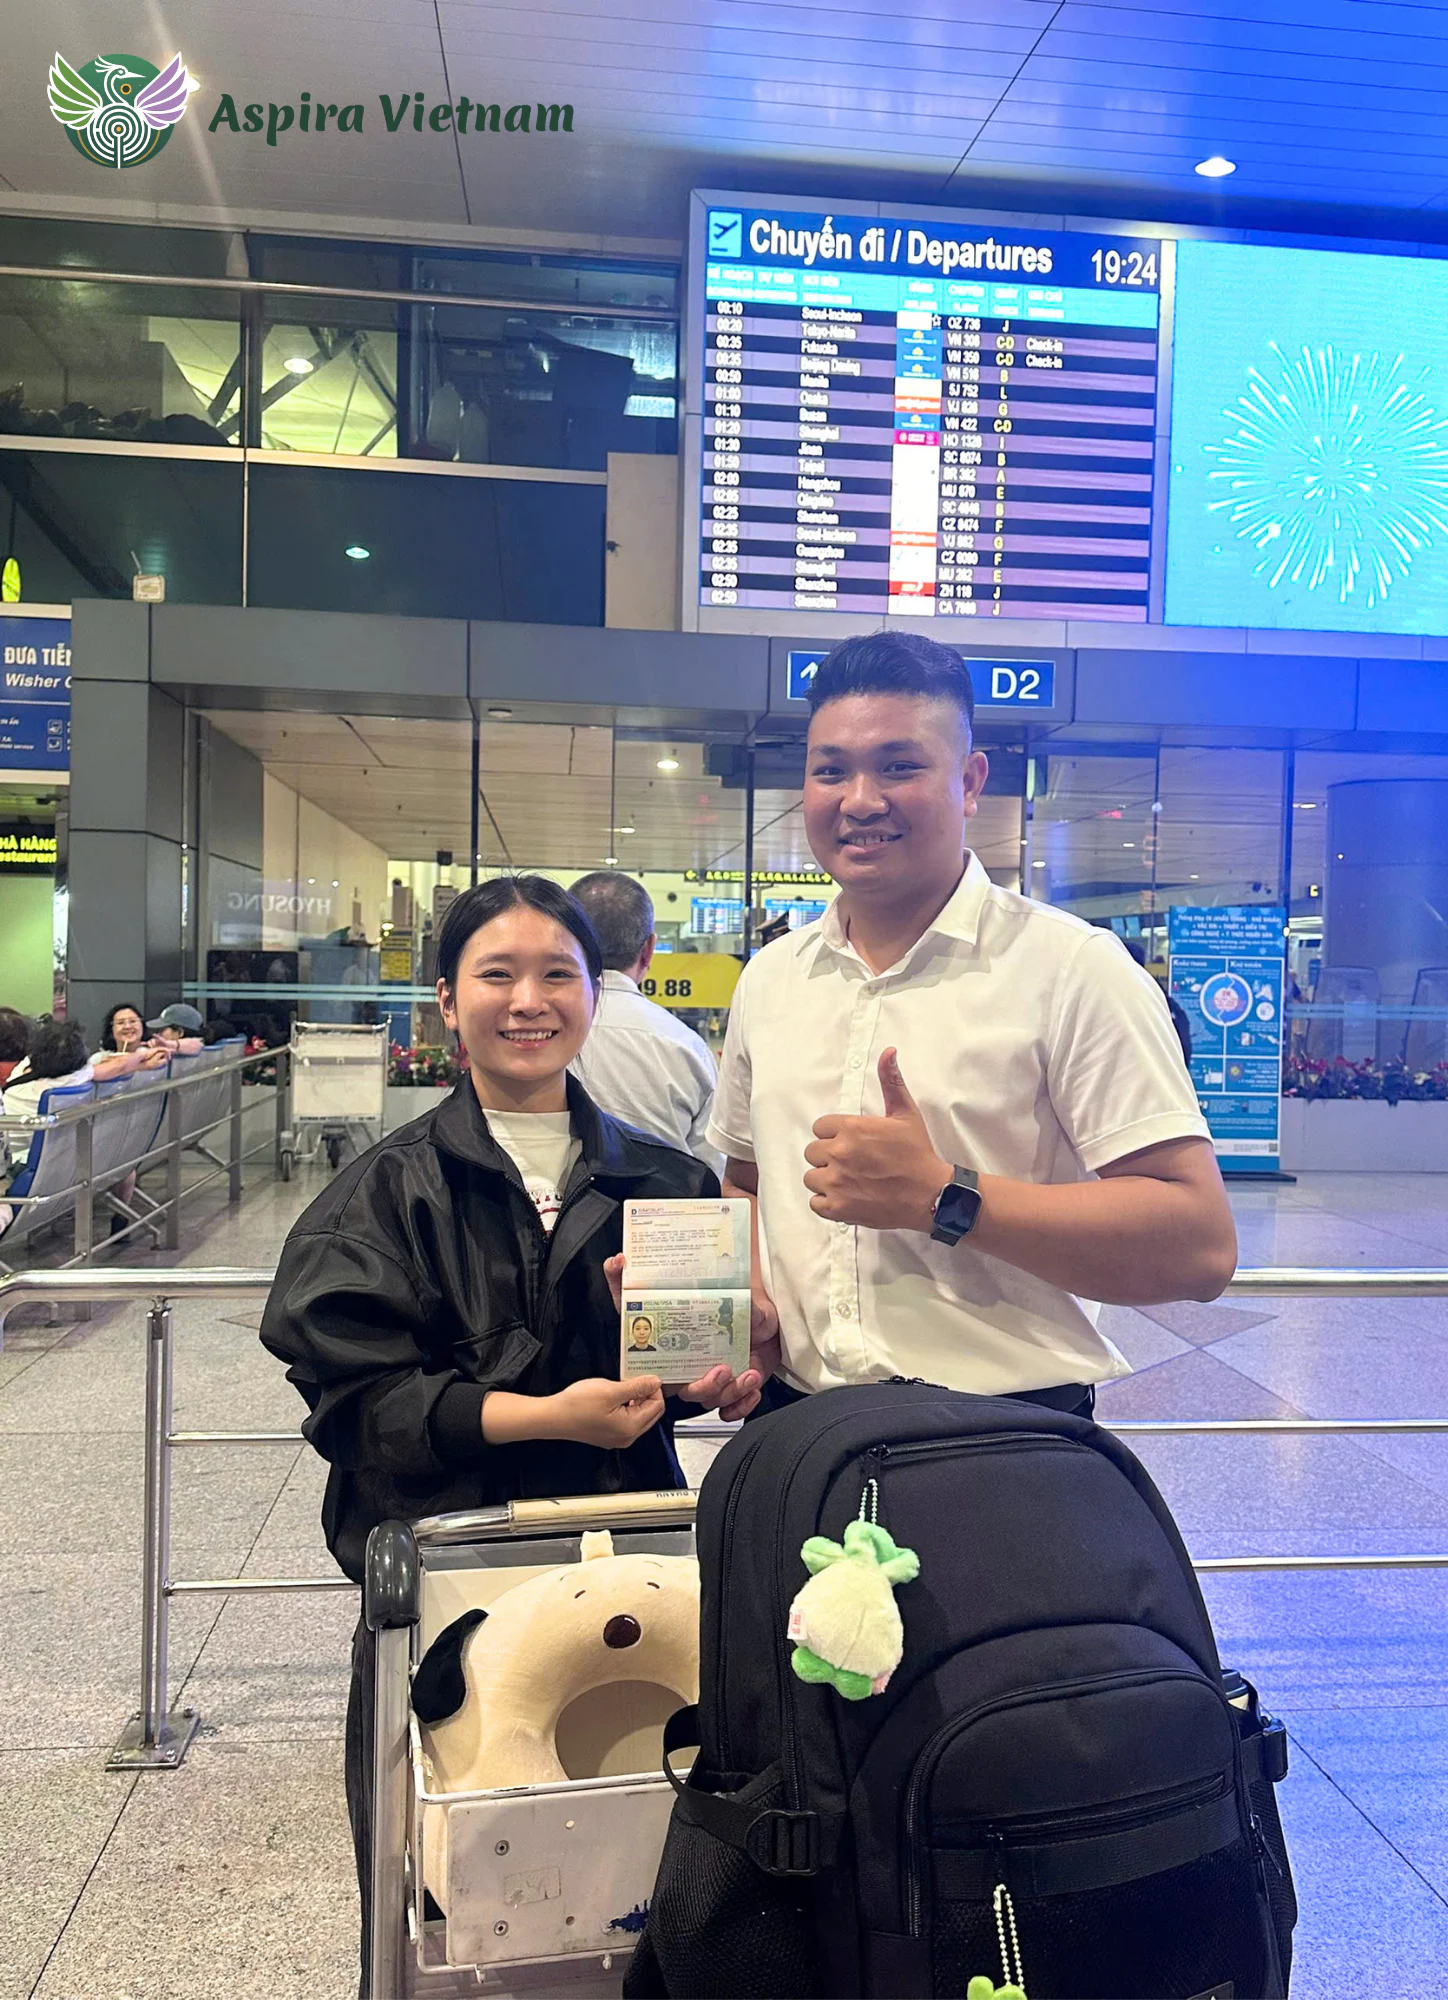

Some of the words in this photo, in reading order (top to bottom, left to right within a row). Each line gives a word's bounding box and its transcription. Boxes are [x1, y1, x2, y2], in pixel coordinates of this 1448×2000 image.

[749, 216, 853, 265] Chuyến
[859, 227, 885, 262] đi
[907, 230, 1053, 275] Departures
[1091, 249, 1158, 286] 19:24
[717, 301, 743, 315] 00:10
[947, 317, 962, 330] OZ
[947, 332, 962, 346] VN
[1026, 337, 1063, 352] Check-in
[947, 350, 962, 363] VN
[1026, 354, 1062, 368] Check-in
[946, 366, 961, 380] VN
[715, 368, 742, 384] 00:50
[962, 384, 979, 398] 752
[947, 399, 960, 414] VJ
[715, 403, 741, 417] 01:10
[945, 417, 959, 430] VN
[943, 450, 958, 464] SC
[942, 517, 956, 531] CZ
[941, 550, 955, 564] CZ
[938, 600, 954, 614] CA
[4, 646, 37, 665] ĐƯA
[5, 673, 61, 689] Wisher
[991, 667, 1040, 700] D2
[20, 835, 57, 851] HÀNG
[637, 978, 691, 997] 9.88
